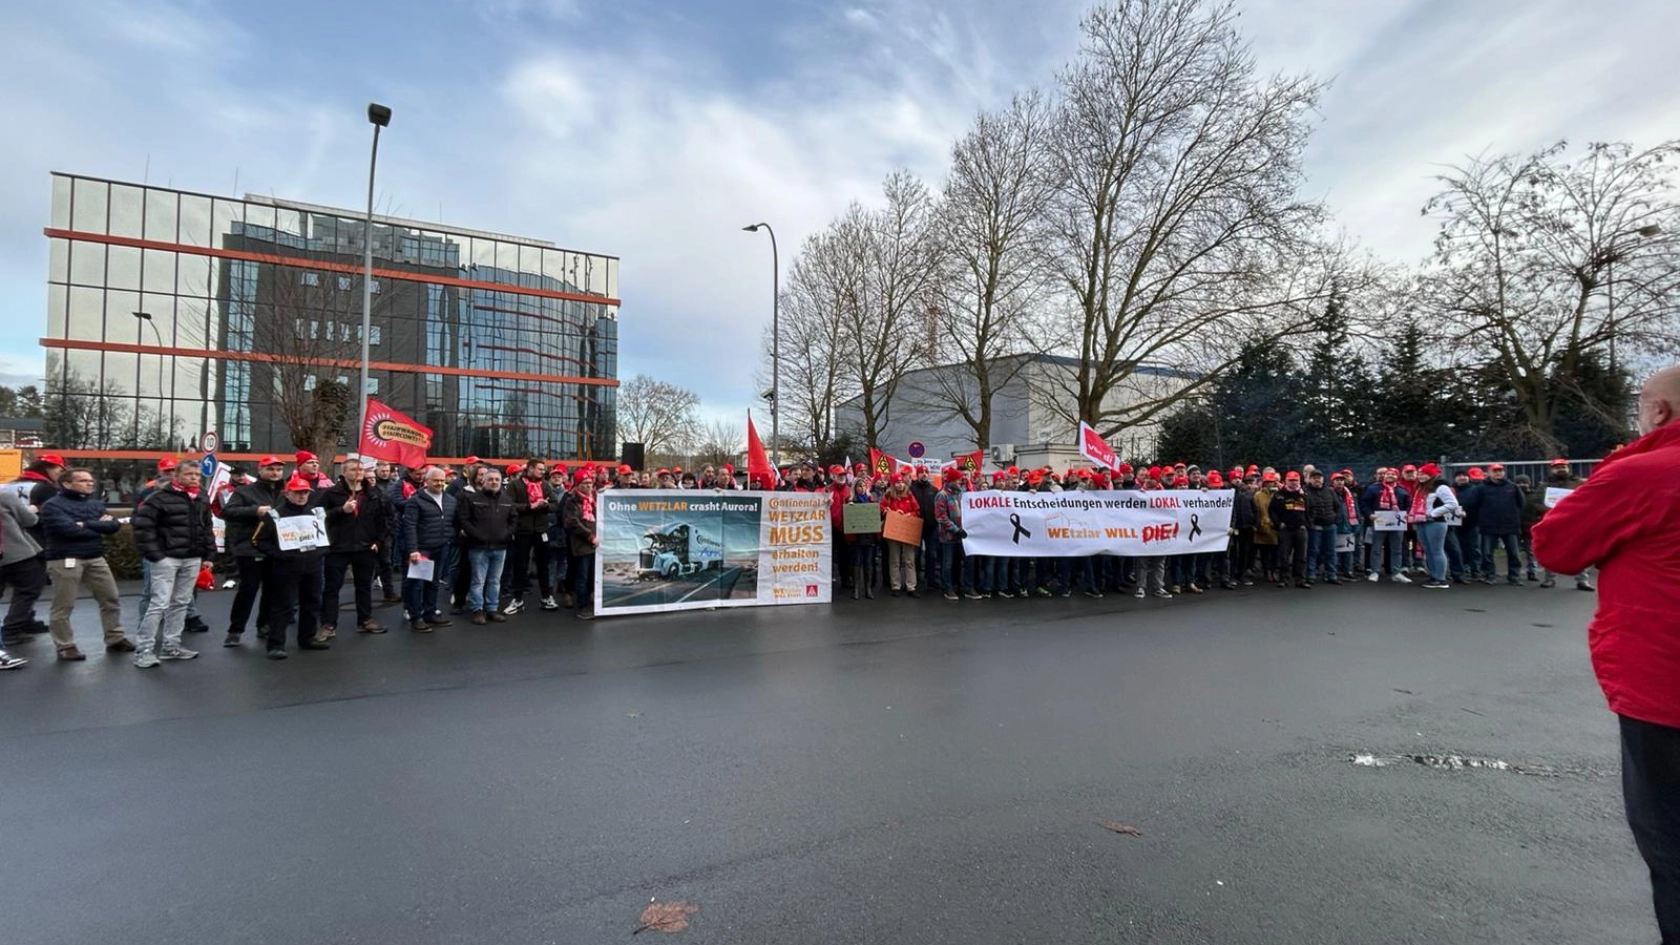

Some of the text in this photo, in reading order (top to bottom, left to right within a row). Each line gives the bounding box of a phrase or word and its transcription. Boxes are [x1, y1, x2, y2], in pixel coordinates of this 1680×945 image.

[206, 437, 214, 448] 10
[608, 501, 758, 512] Ohne WETZLAR crasht Aurora!
[768, 498, 820, 509] Continental
[969, 497, 1011, 509] LOKALE
[1014, 498, 1102, 511] Entscheidungen
[1102, 498, 1147, 509] werden
[1150, 497, 1181, 508] LOKAL
[768, 510, 826, 522] WETZLAR
[769, 525, 824, 544] MUSS
[1047, 522, 1180, 543] WEtzlar WILL DIE!
[772, 549, 819, 559] erhalten
[772, 562, 818, 573] werden!
